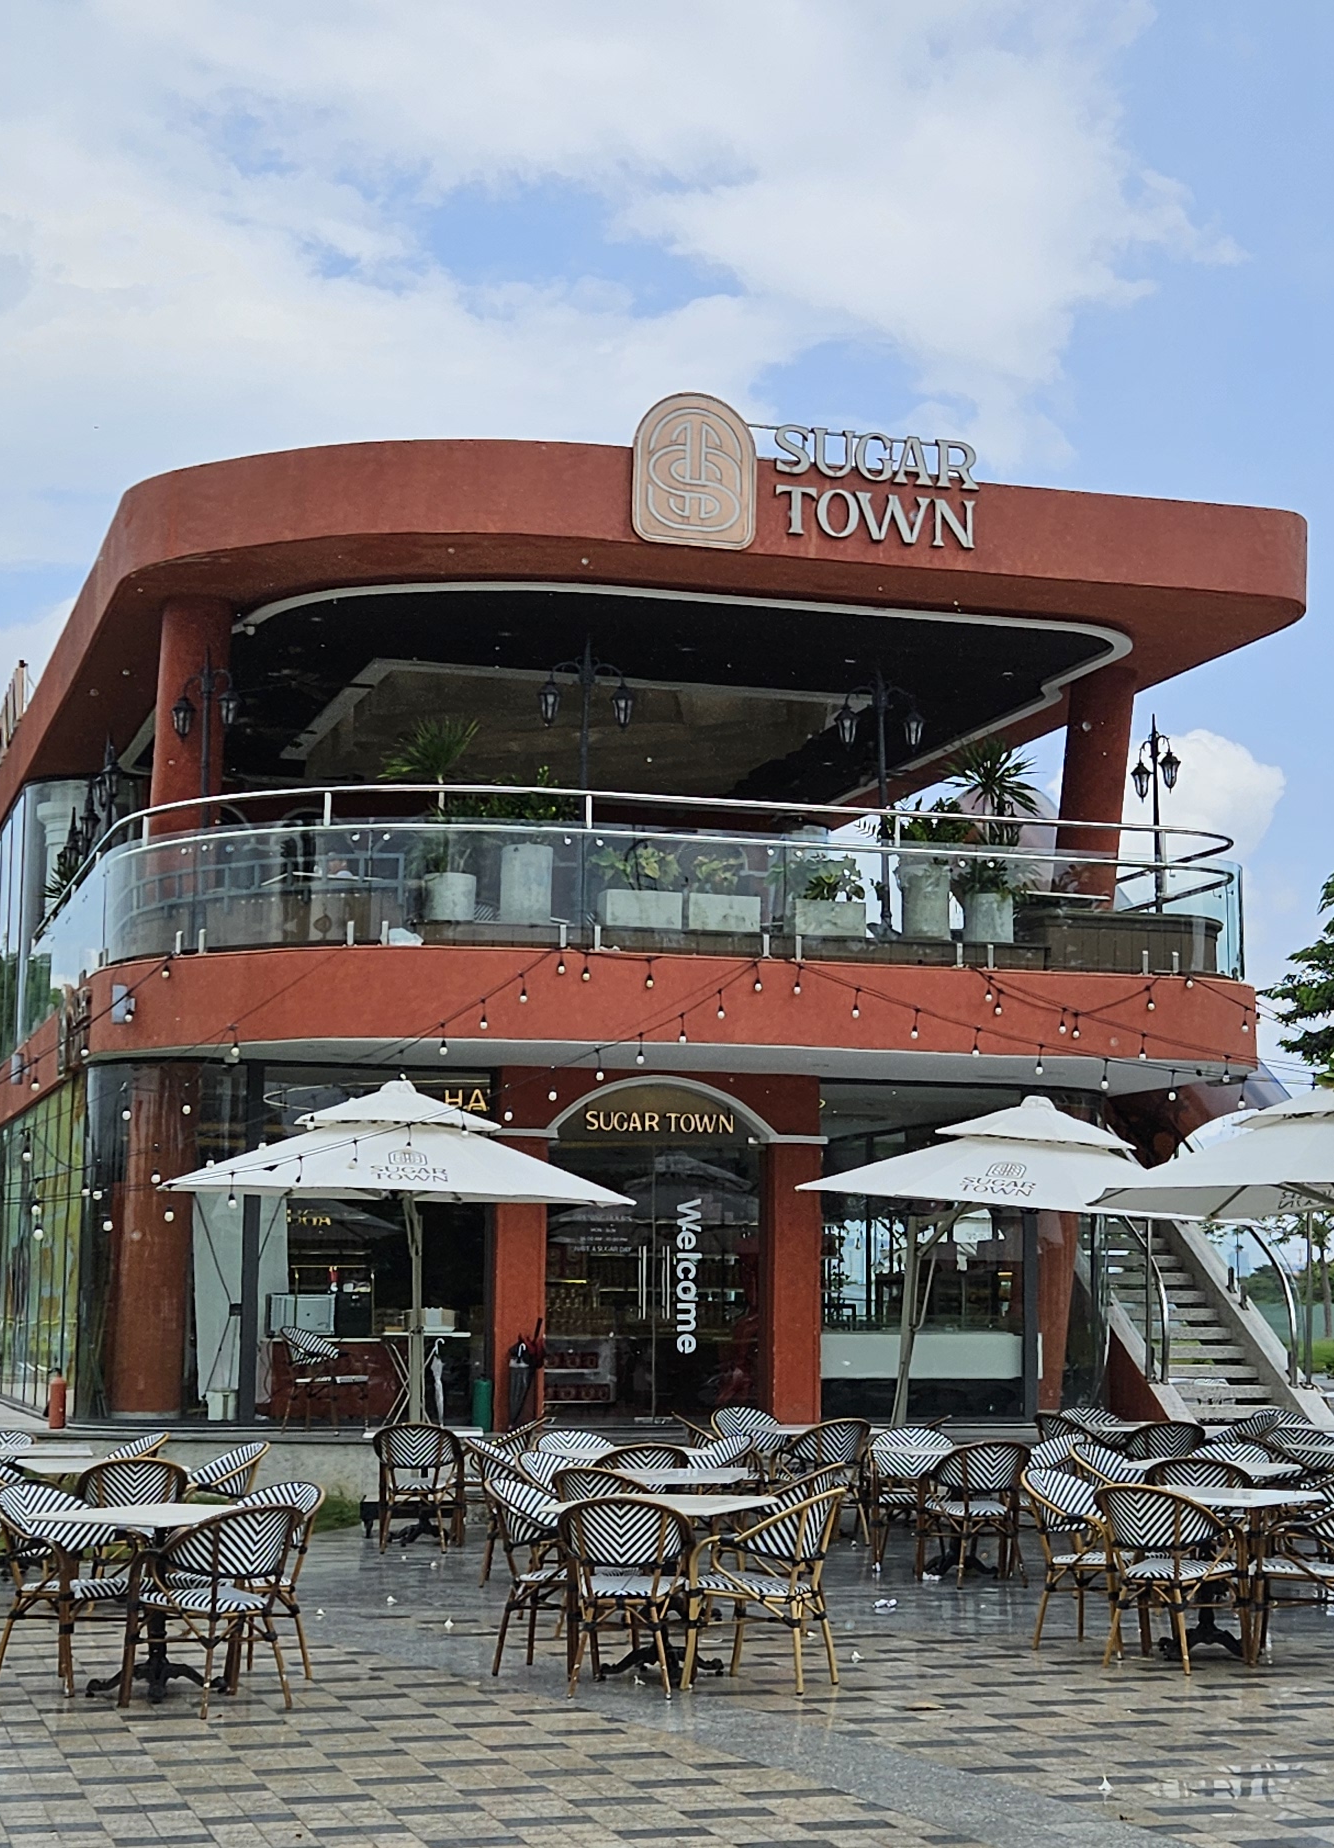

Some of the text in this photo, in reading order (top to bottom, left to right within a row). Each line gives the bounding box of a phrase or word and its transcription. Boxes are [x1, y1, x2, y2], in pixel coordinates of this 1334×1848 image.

[774, 424, 980, 491] SUGAR
[774, 484, 977, 549] TOWN
[585, 1110, 734, 1134] SUGAR TOWN
[370, 1165, 448, 1175] SUGAR
[370, 1172, 449, 1182] TOWN
[959, 1183, 1033, 1197] TOWN
[962, 1176, 1036, 1190] SUGAR
[676, 1198, 703, 1354] Welcome
